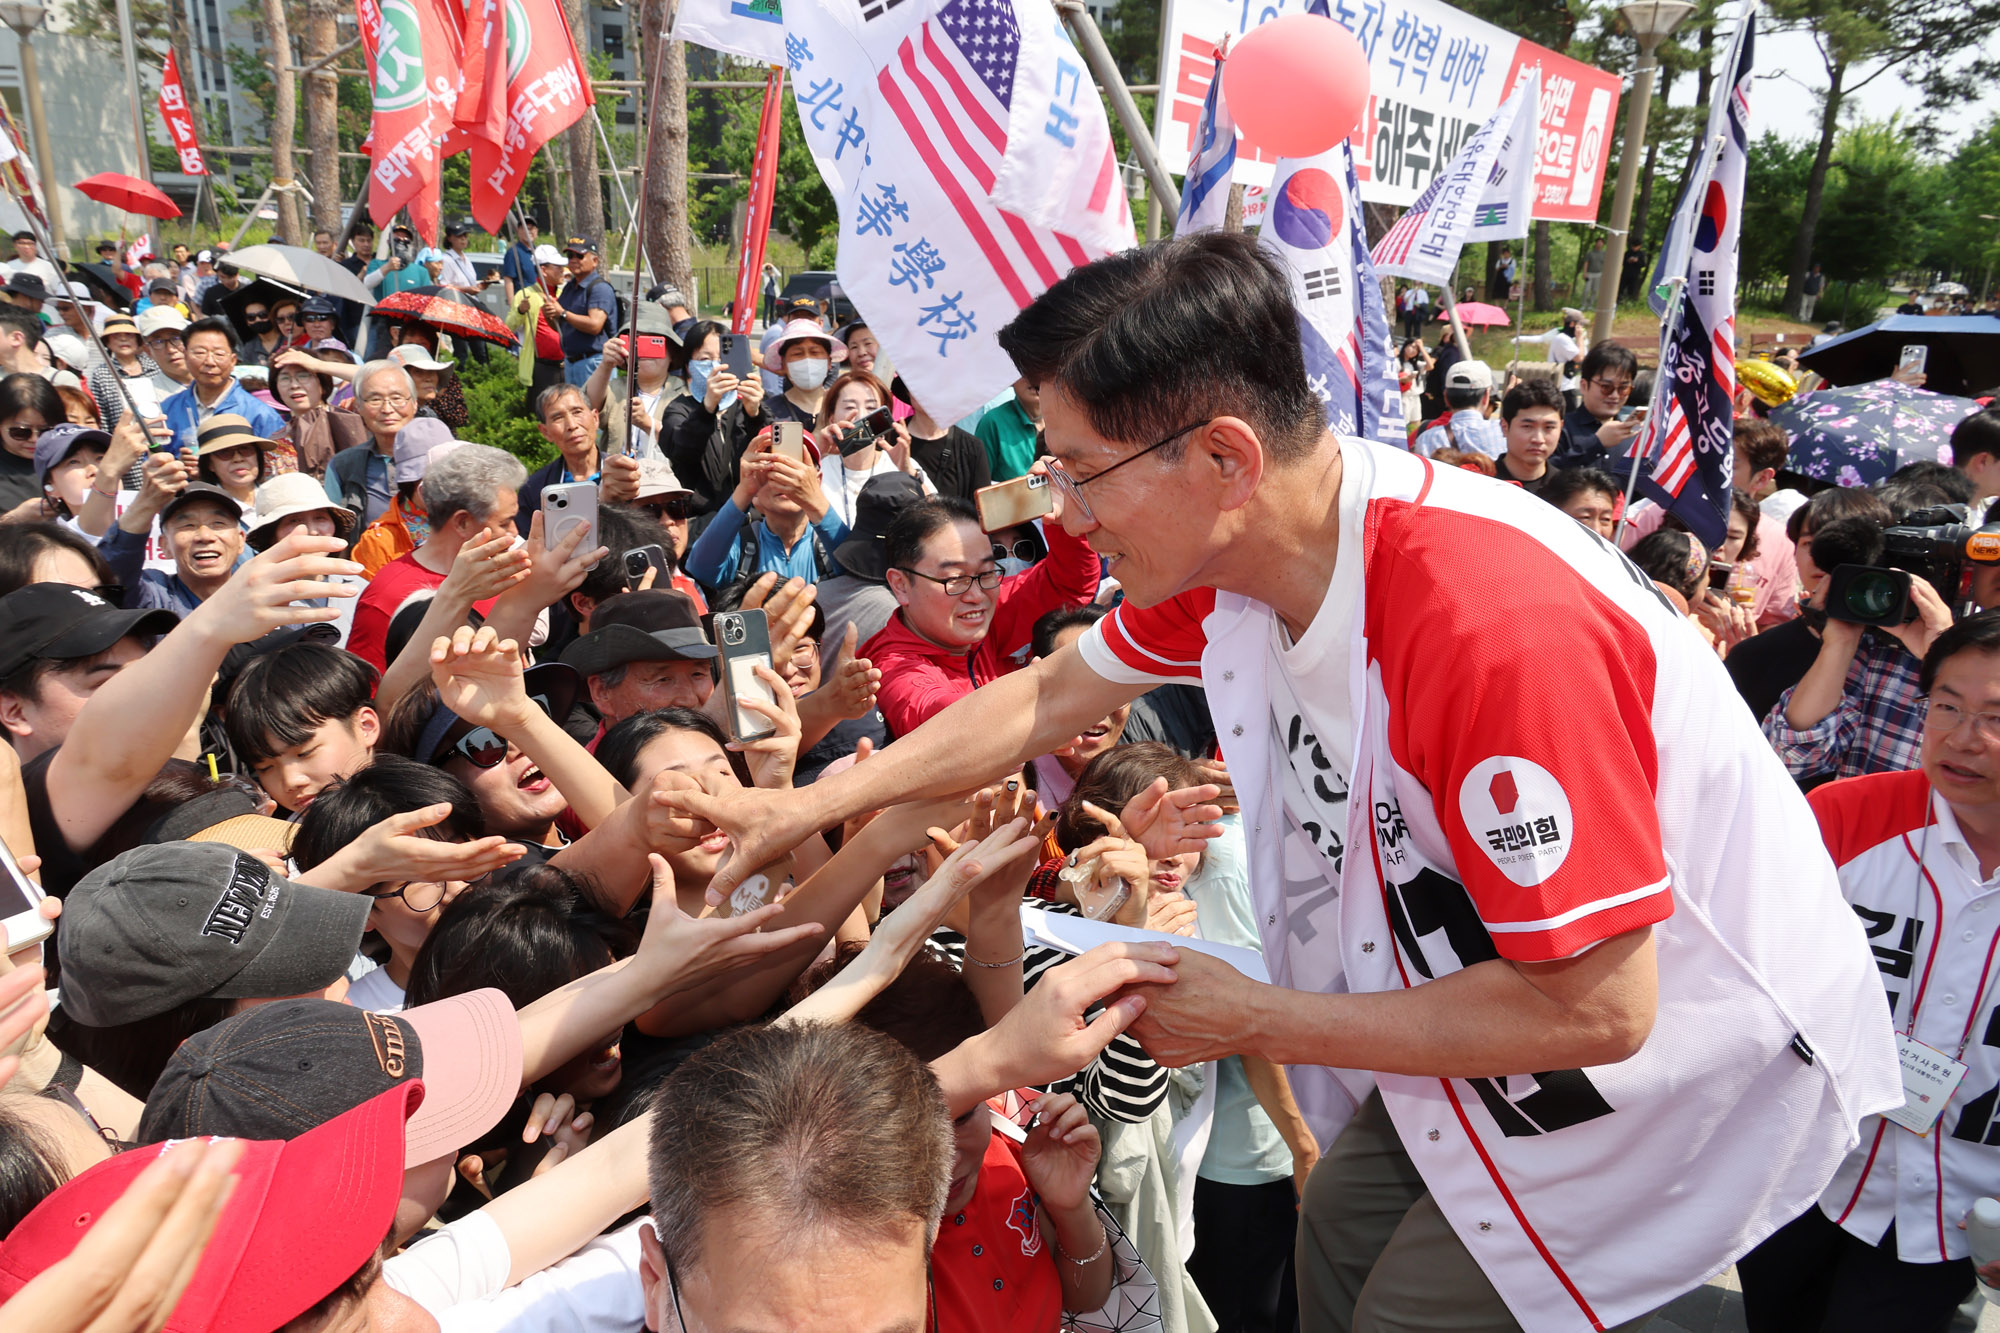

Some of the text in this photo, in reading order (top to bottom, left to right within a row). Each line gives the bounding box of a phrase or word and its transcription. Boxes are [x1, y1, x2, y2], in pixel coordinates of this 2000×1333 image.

[1388, 9, 1442, 95] 학력
[1440, 36, 1489, 109] 비하
[1972, 536, 2000, 547] MBN
[1973, 547, 1999, 555] NEWS
[1485, 815, 1561, 853] 국민의힘
[1497, 855, 1517, 865] PEOPLE
[1538, 845, 1564, 857] PARTY
[201, 888, 258, 946] NEW
